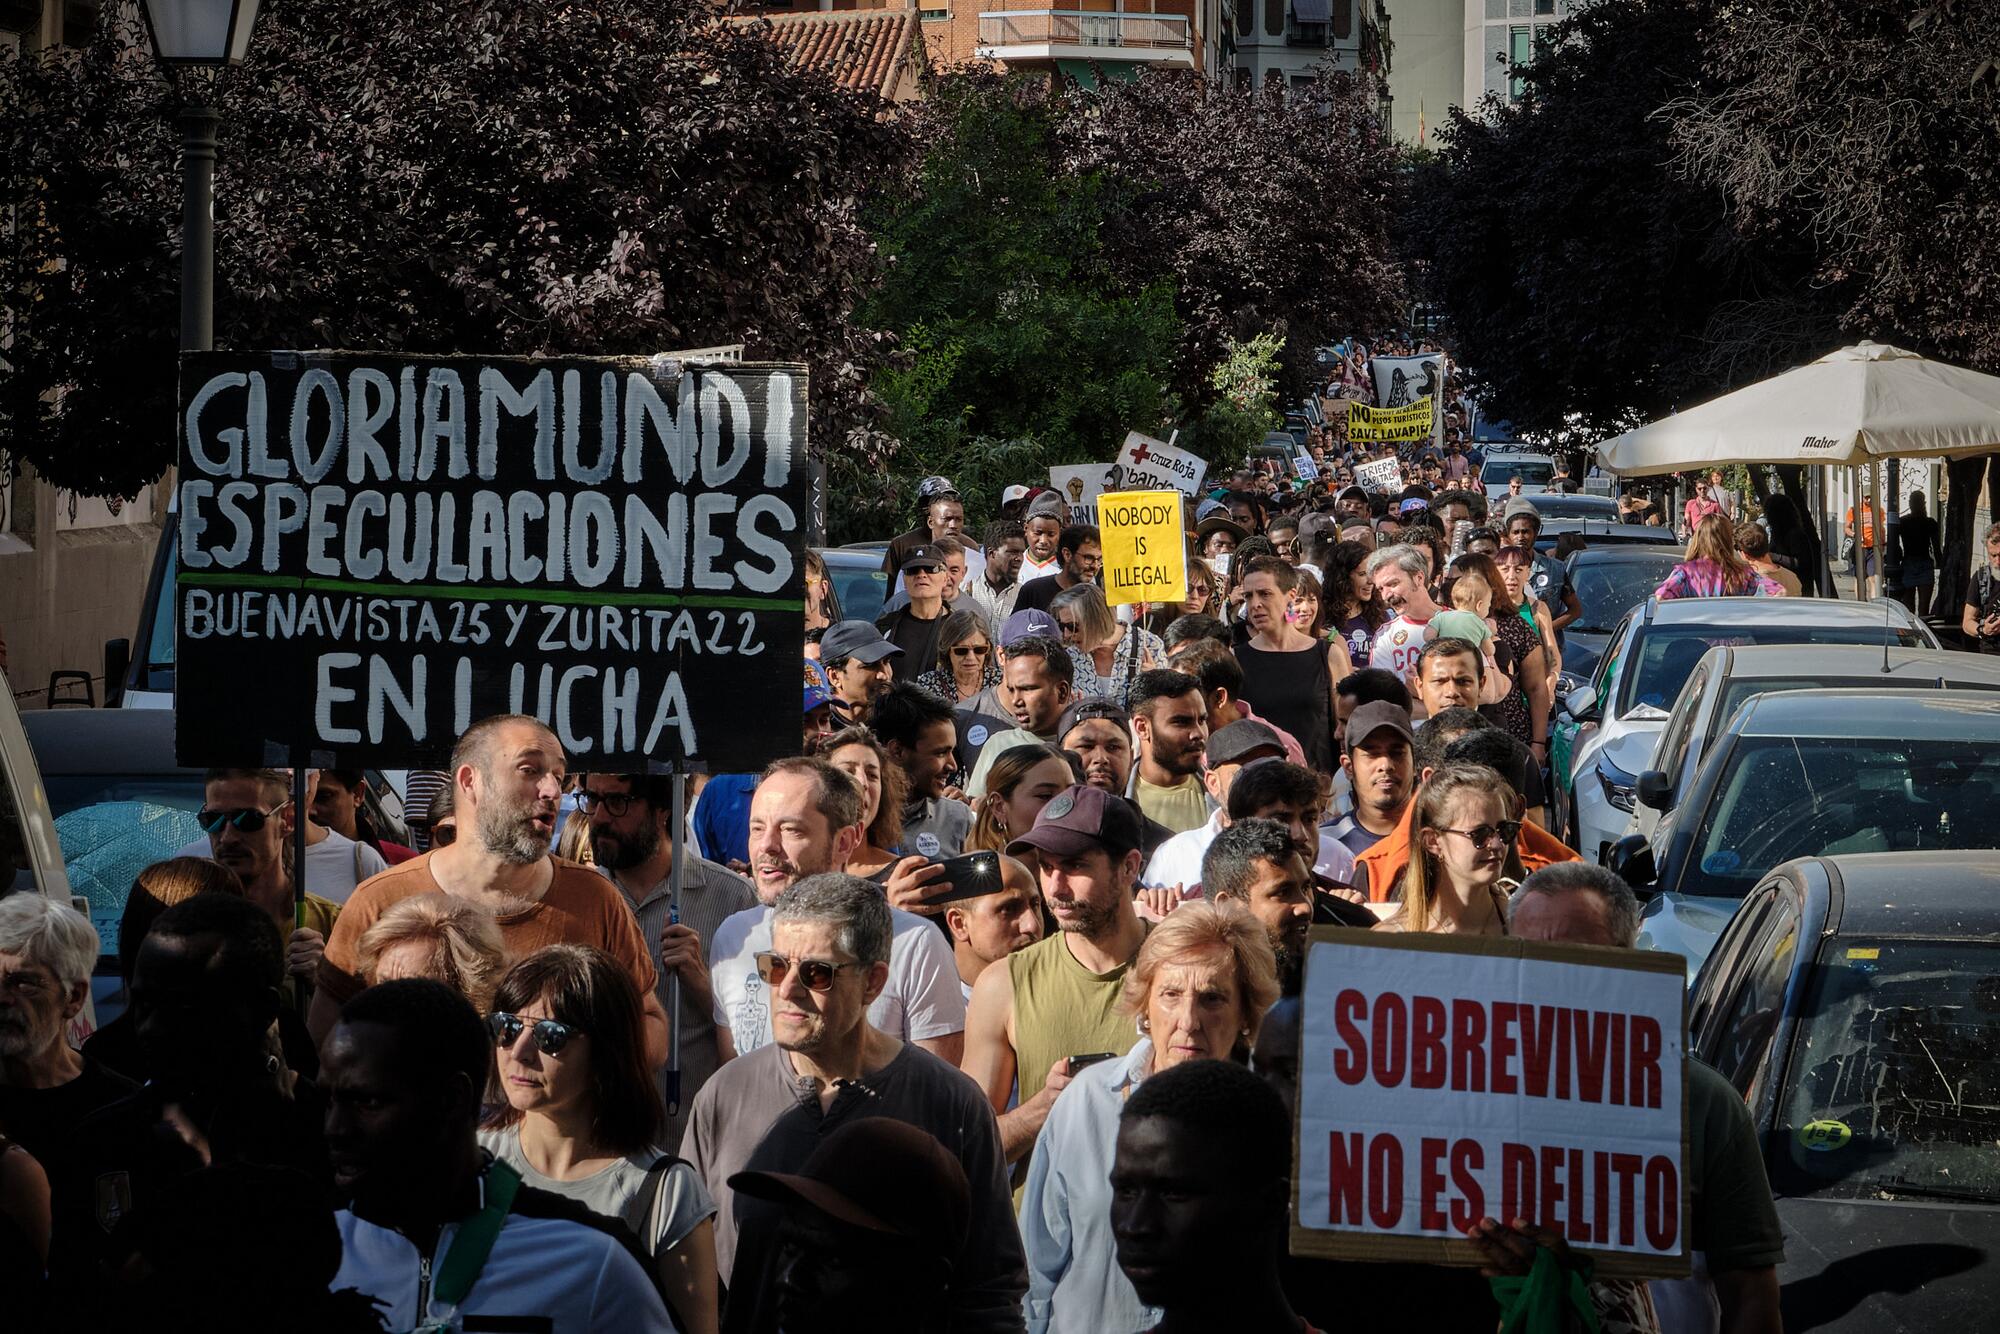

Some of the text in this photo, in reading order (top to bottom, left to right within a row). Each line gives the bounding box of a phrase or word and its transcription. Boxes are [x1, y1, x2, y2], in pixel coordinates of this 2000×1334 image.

[1352, 403, 1370, 424] NO
[1372, 411, 1430, 425] PISOS TURÍSTICOS
[1350, 421, 1431, 440] SAVE LAVAPIÉS
[1172, 459, 1196, 480] Roja
[1362, 472, 1395, 487] CAPITAL
[1105, 505, 1172, 528] NOBODY
[179, 478, 797, 594] ESPECULACIONES
[1134, 536, 1148, 556] IS
[1113, 565, 1172, 589] ILLEGAL
[505, 603, 528, 648] Y
[315, 652, 427, 745] EN
[1334, 988, 1661, 1109] SOBREVIVIR
[1328, 1131, 1679, 1252] NO ES DELITO
